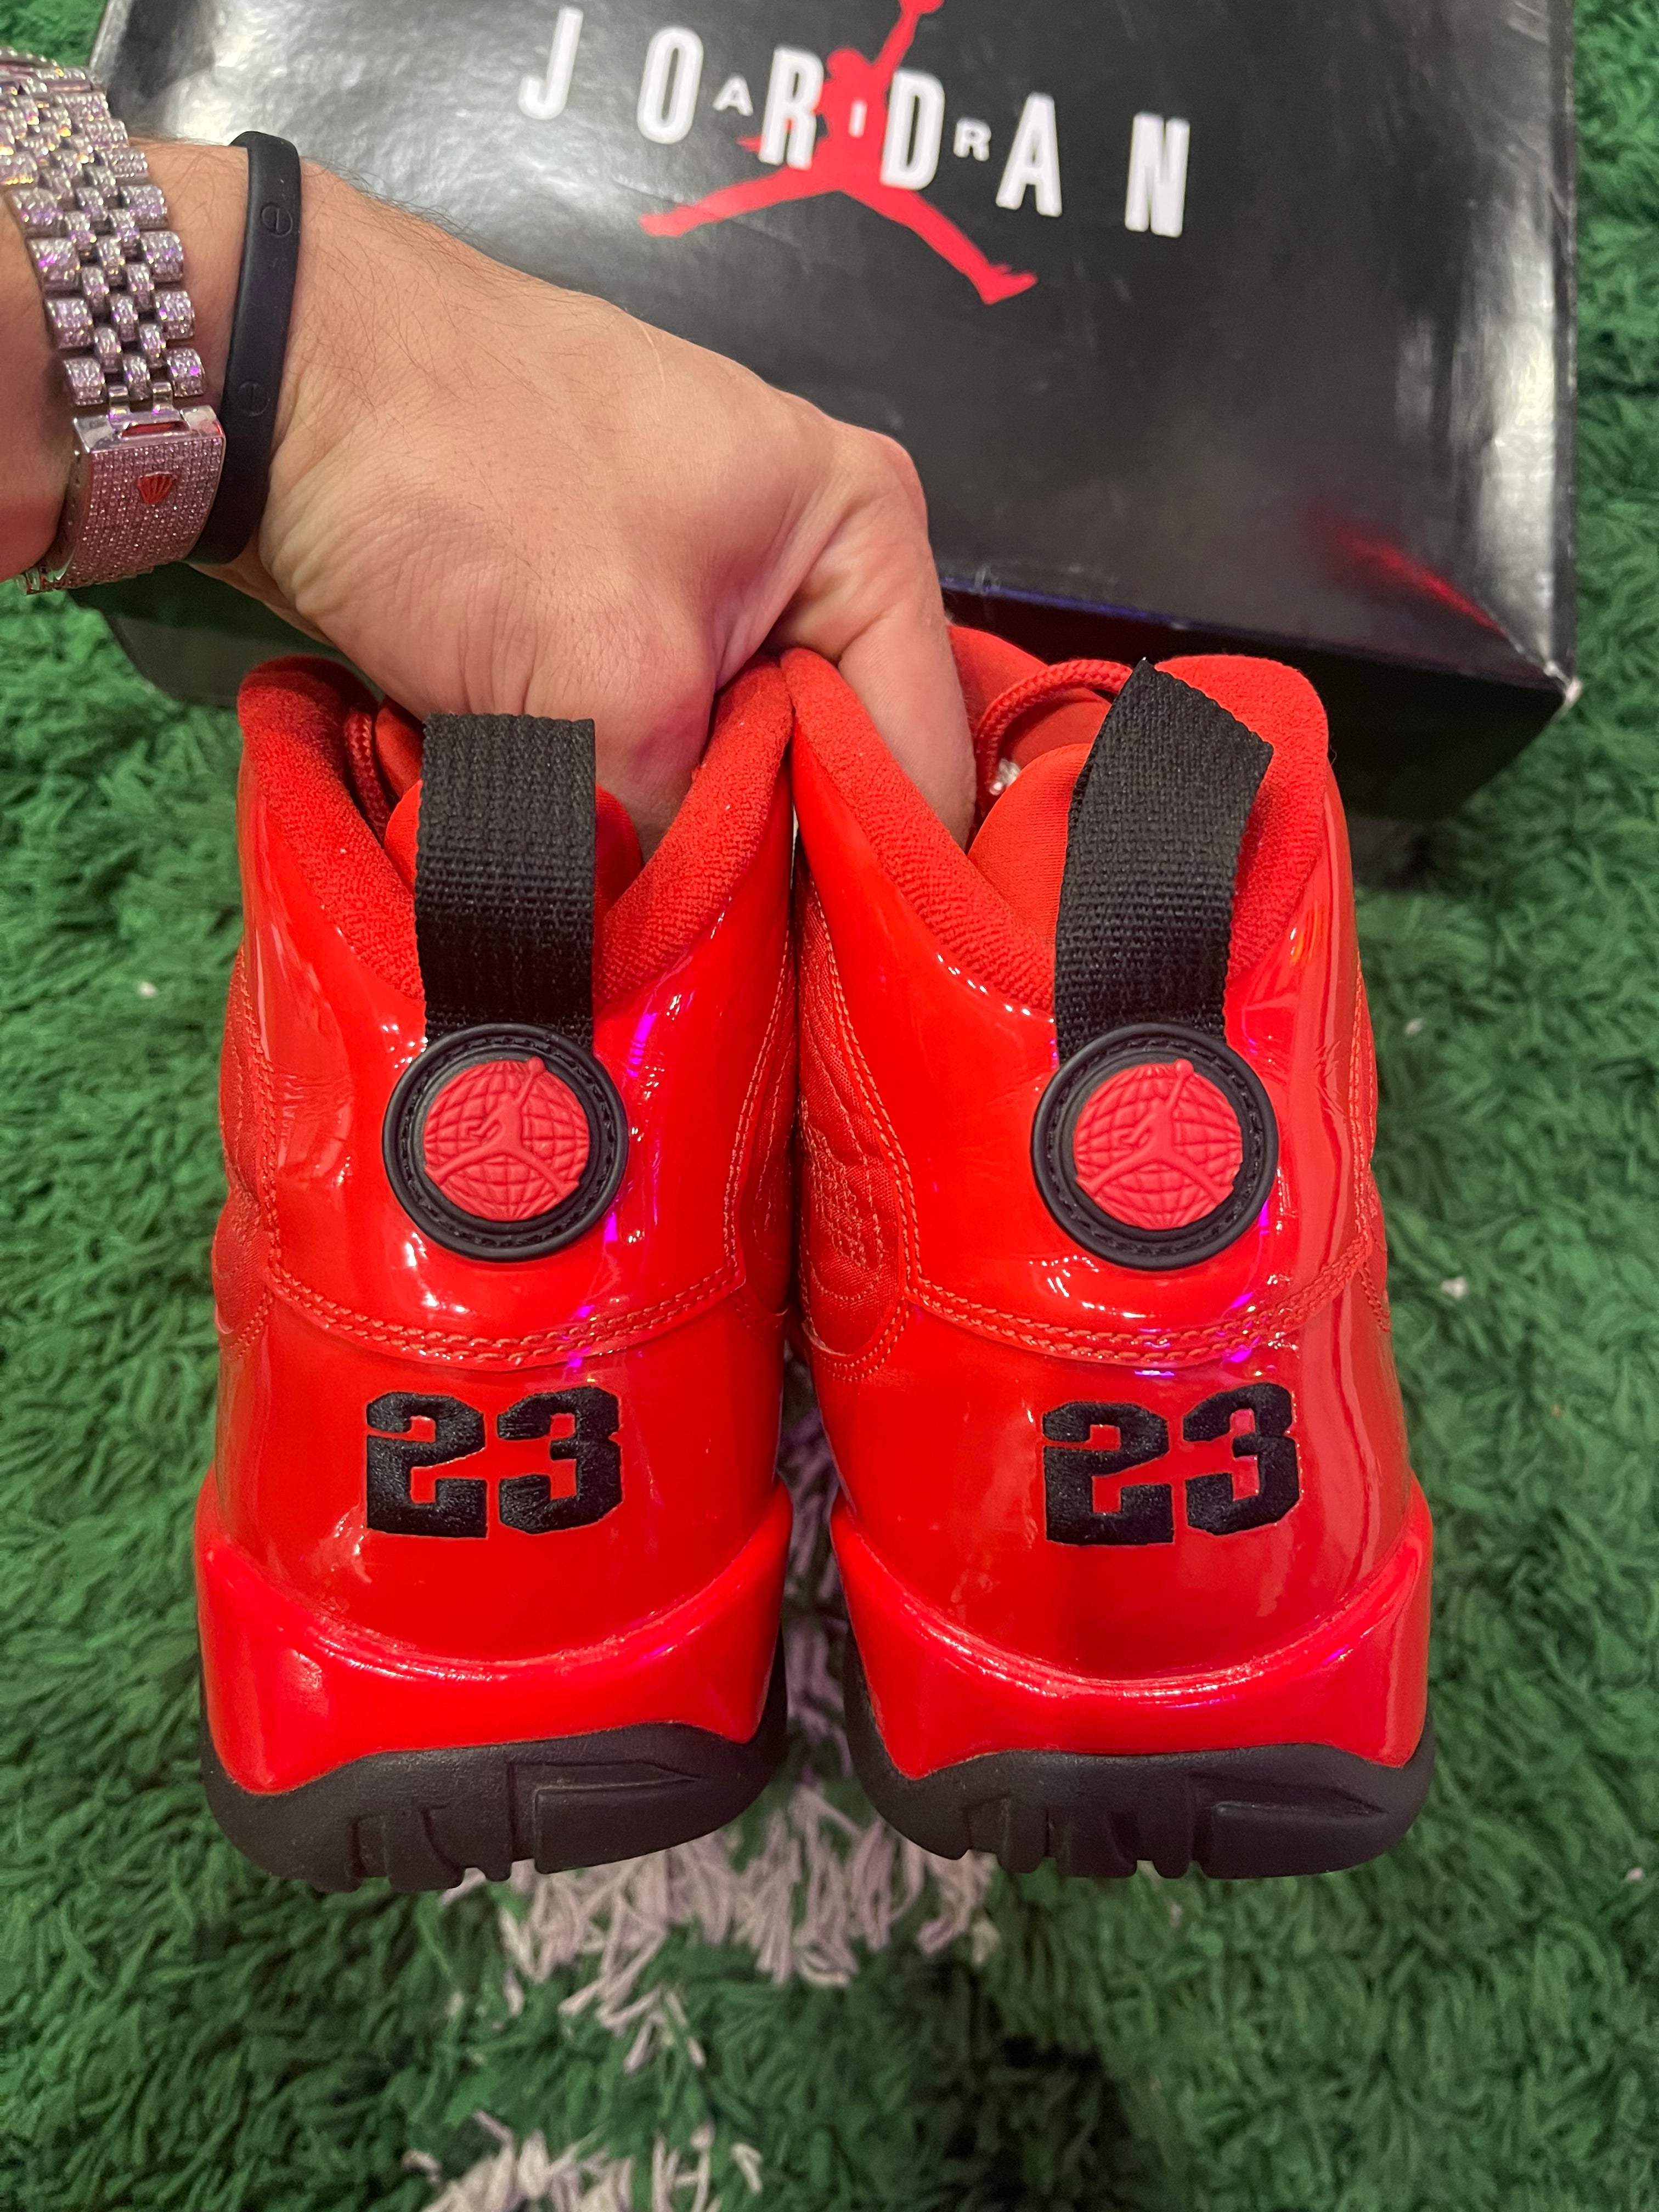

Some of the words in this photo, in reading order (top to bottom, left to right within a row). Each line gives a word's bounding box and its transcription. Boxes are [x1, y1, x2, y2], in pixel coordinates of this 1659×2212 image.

[518, 7, 1190, 238] JORDAN
[366, 1386, 623, 1539] 23
[1042, 1382, 1300, 1547] 23
